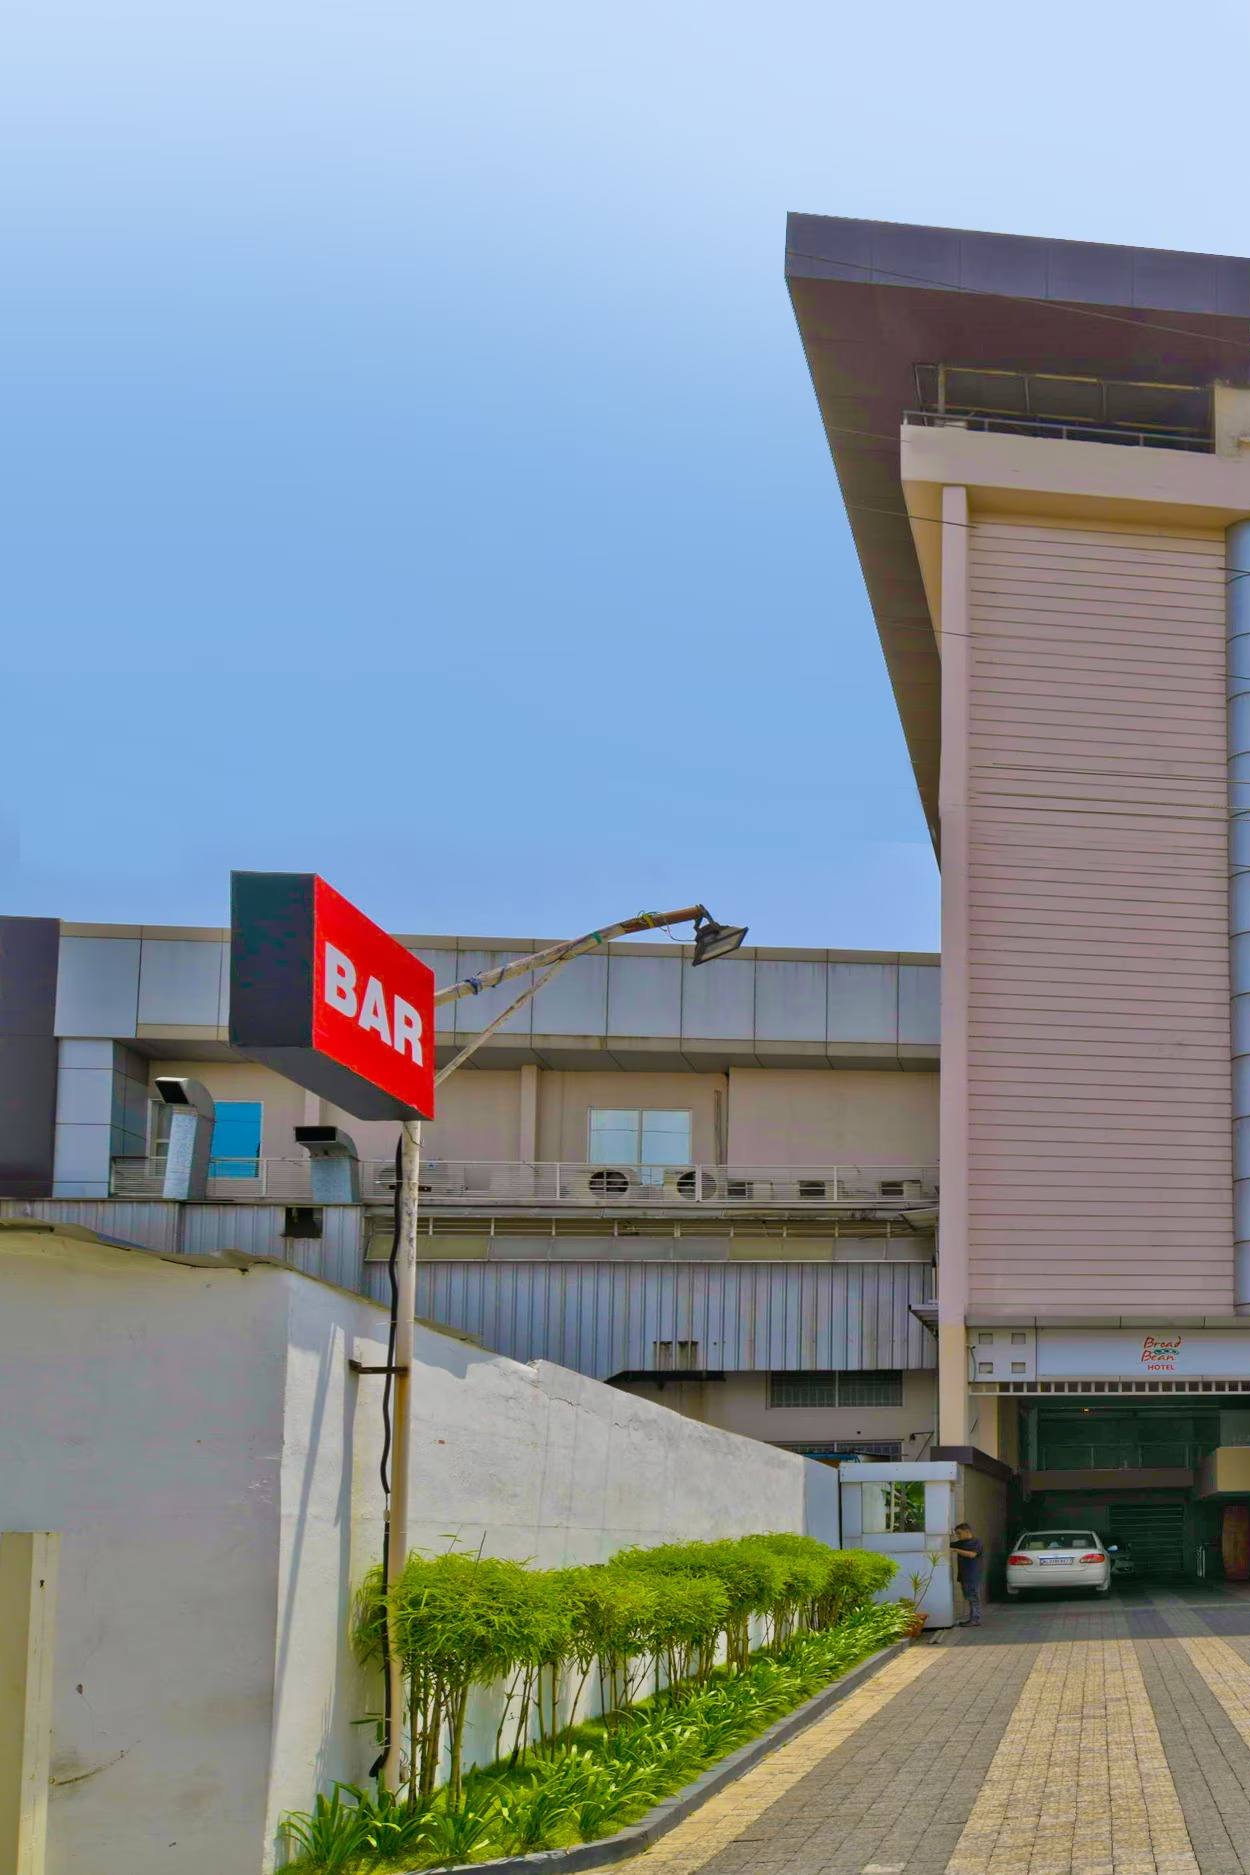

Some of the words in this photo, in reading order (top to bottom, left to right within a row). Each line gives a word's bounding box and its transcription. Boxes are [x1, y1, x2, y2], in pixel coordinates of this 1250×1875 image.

[325, 941, 424, 1067] BAR
[1143, 1335, 1182, 1349] Broad
[1141, 1349, 1175, 1362] Bean
